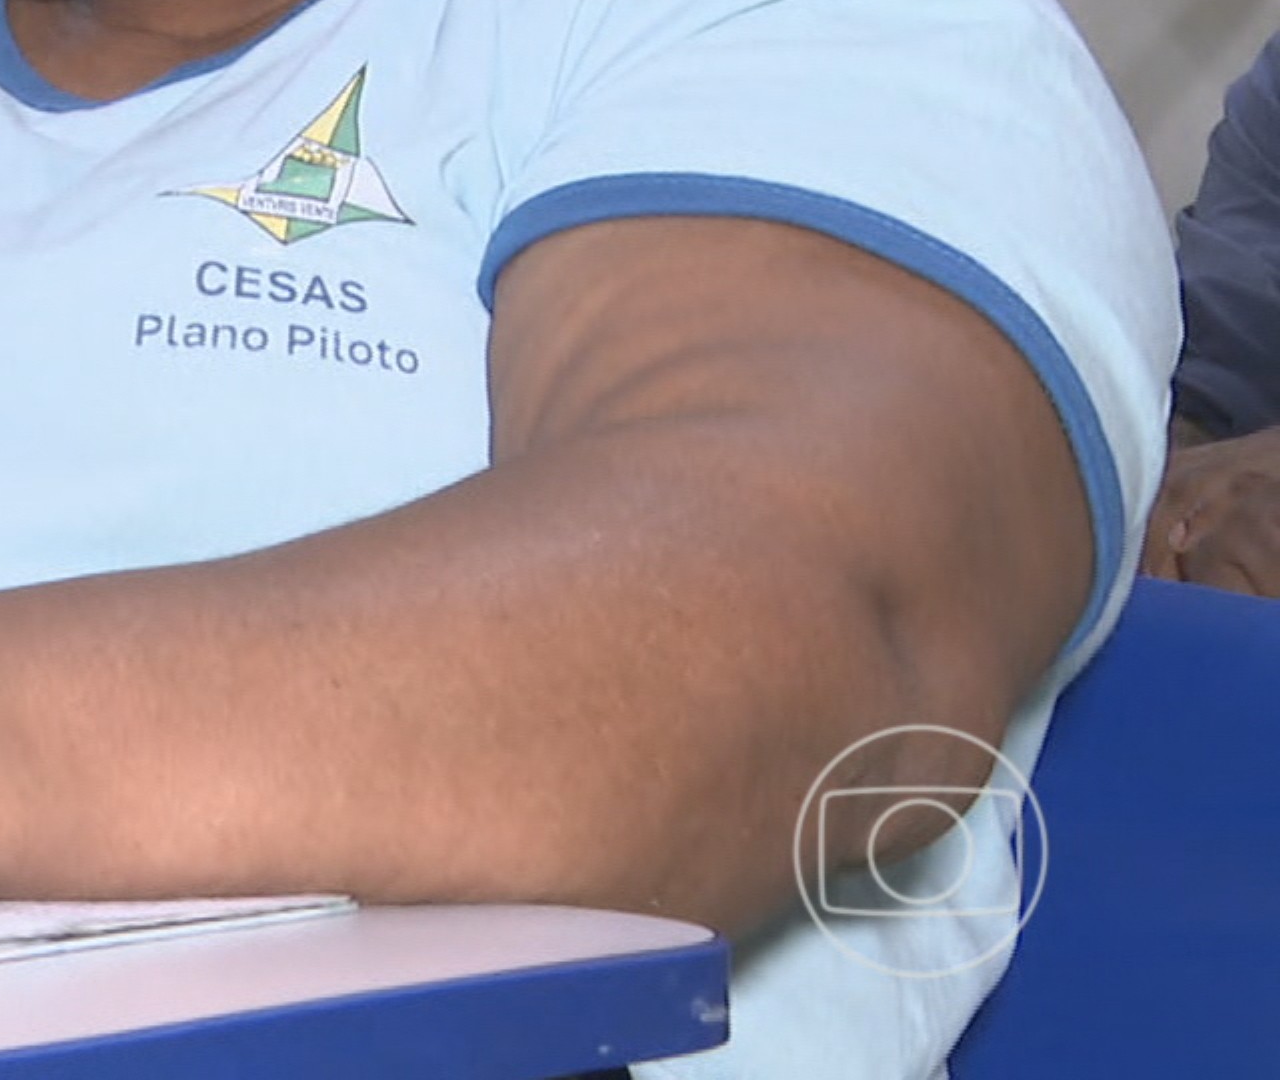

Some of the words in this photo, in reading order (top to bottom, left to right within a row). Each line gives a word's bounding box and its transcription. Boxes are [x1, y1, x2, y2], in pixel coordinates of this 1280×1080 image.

[196, 261, 367, 313] CESAS
[135, 315, 268, 352] Plano
[287, 324, 420, 375] Piloto
